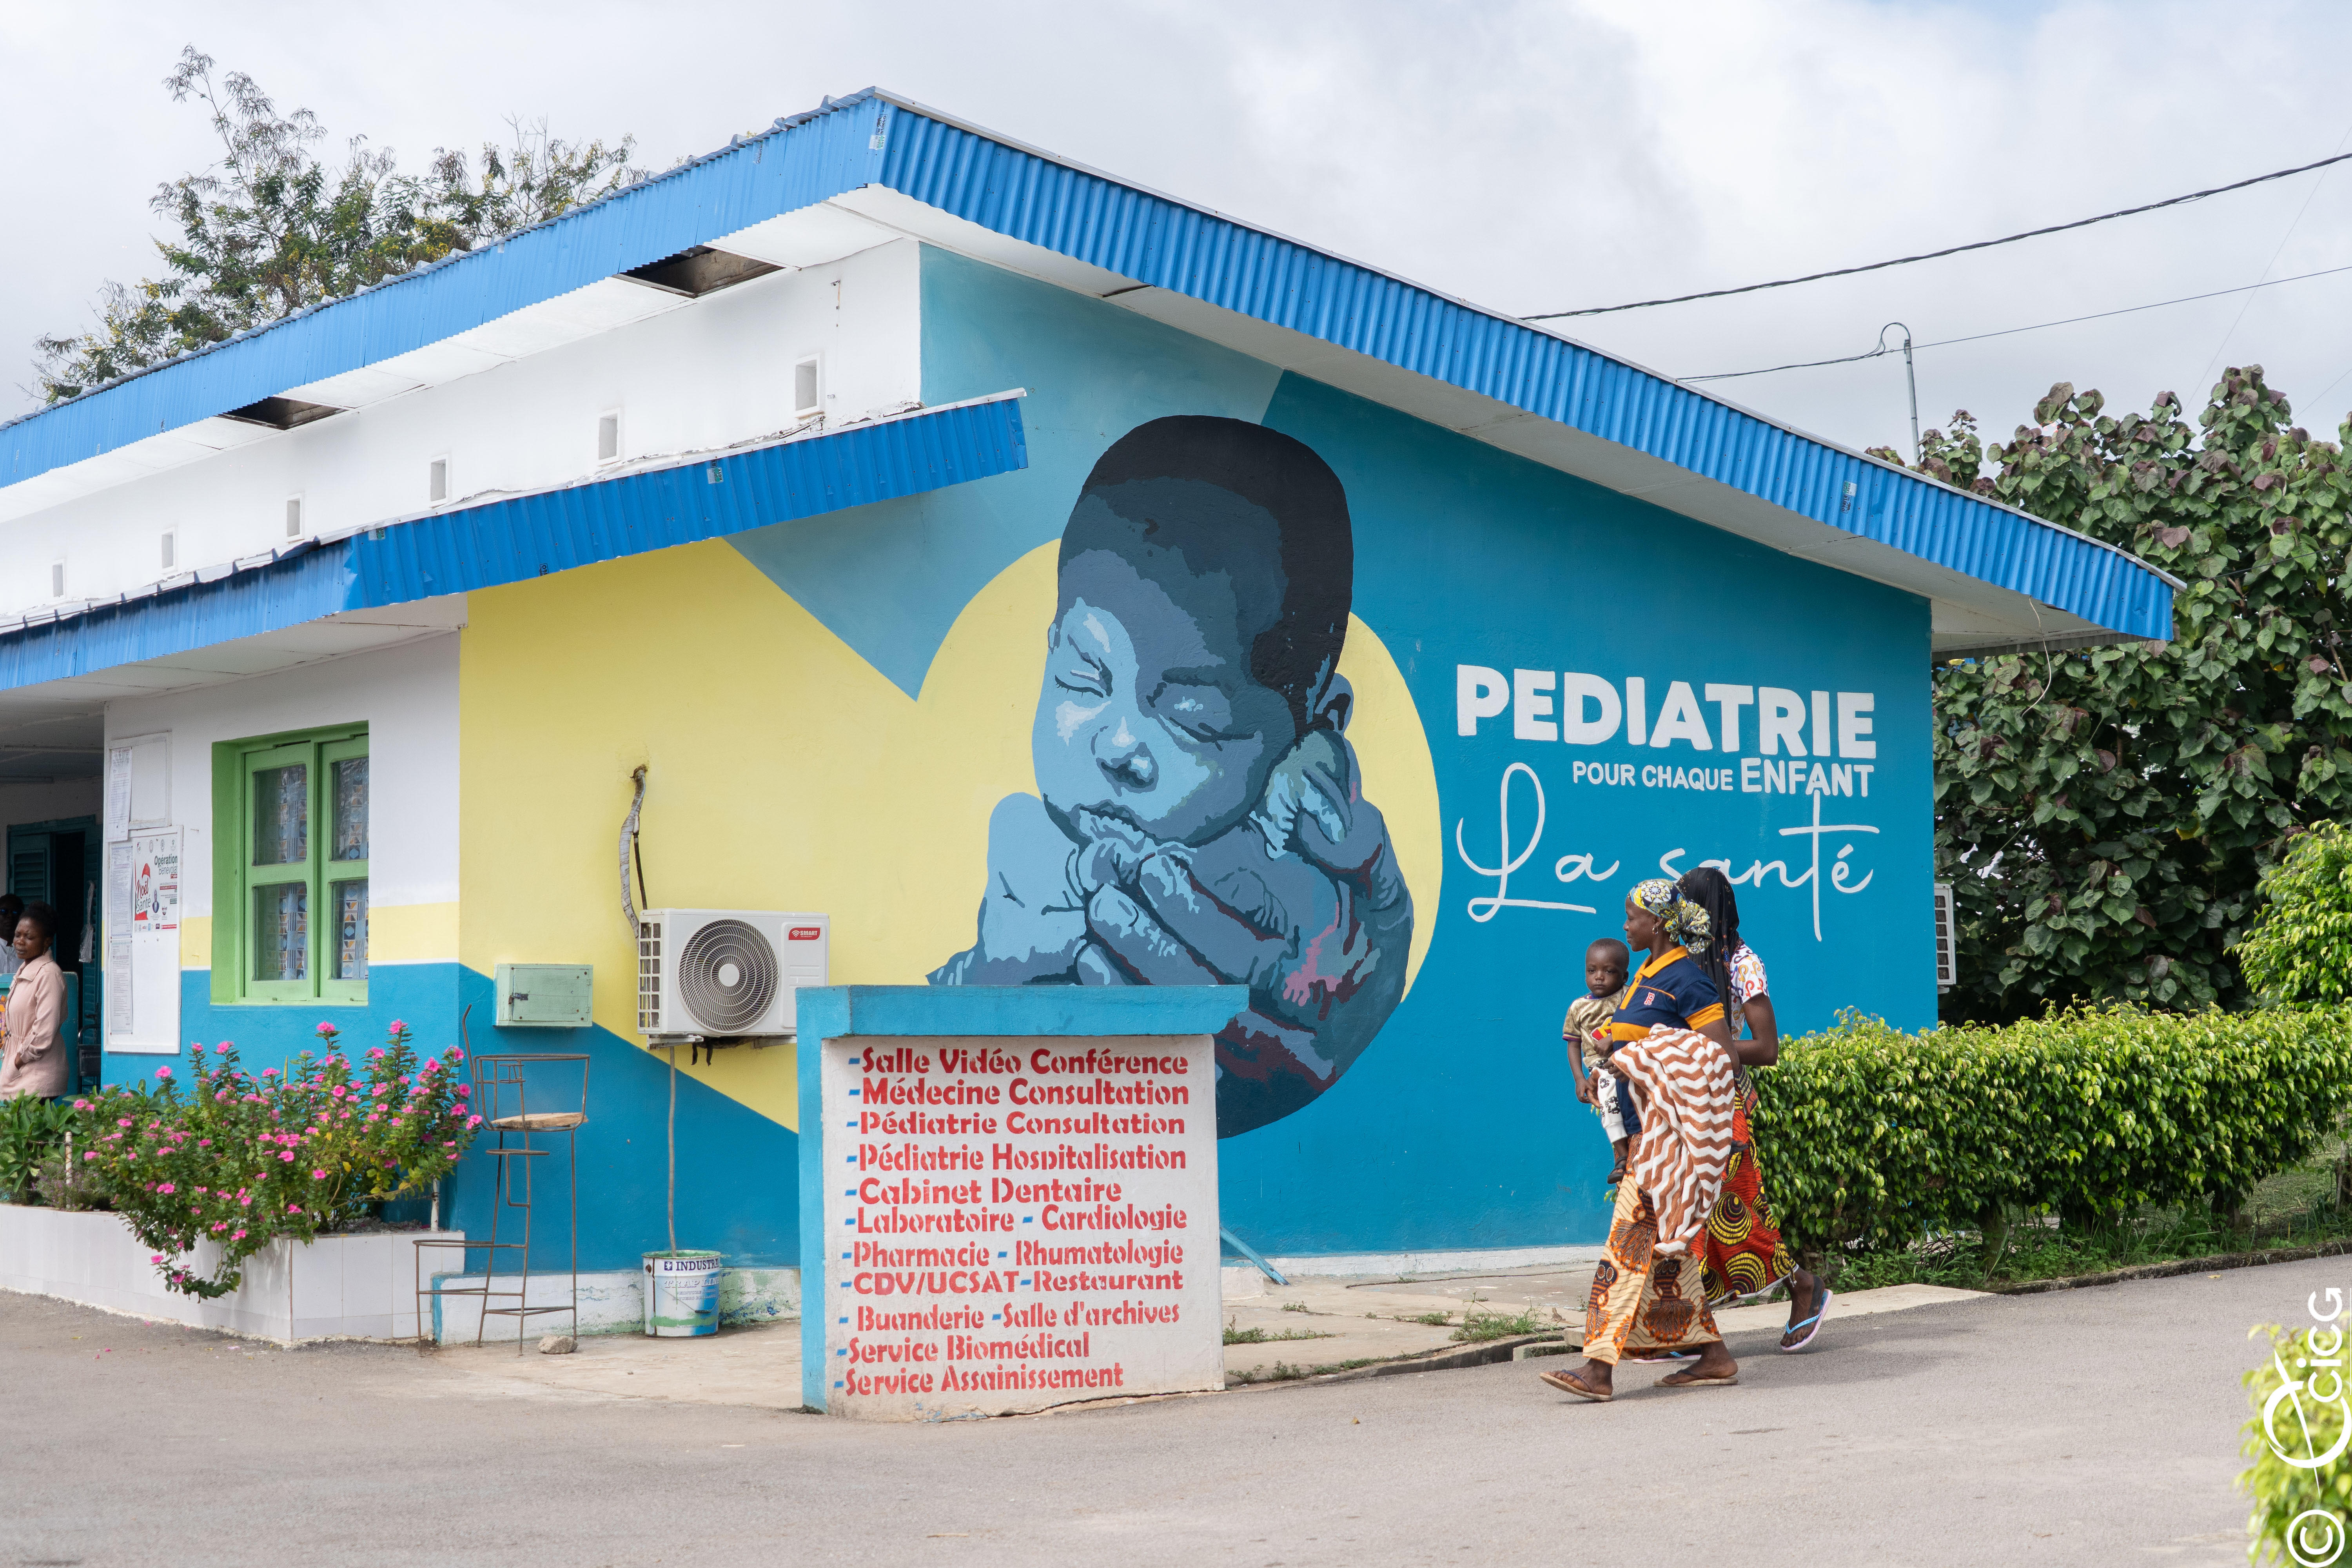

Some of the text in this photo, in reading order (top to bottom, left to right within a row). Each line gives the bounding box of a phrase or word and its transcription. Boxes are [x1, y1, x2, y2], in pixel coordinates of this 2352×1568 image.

[1456, 664, 1877, 759] PEDIATRIE
[1573, 757, 1875, 798] POUR CHAQUE ENFANT
[1455, 762, 1620, 922] La
[154, 853, 178, 867] Opération
[159, 864, 178, 875] Bénévolat
[136, 878, 149, 899] Noël
[137, 894, 151, 912] Santé
[862, 1047, 1188, 1074] Salle Vidéo Conférence
[863, 1077, 1189, 1105] Médecine Consultation
[860, 1111, 1185, 1134] Pédiatrie Consultation
[859, 1142, 1186, 1171] Pédiatrie Hospitalisation
[859, 1177, 1122, 1205] Cabinet Dentaire
[858, 1203, 1187, 1234] Laboratoire Cardiologie
[854, 1238, 1183, 1269] Pharmacie Rhumatologie
[664, 1279, 700, 1288] TRAP
[1034, 1270, 1183, 1292] Restaurant
[857, 1300, 1180, 1332] Buanderie Salle d'archives
[848, 1331, 1089, 1365] Service Biomédical
[846, 1362, 1123, 1396] Service Assainissement
